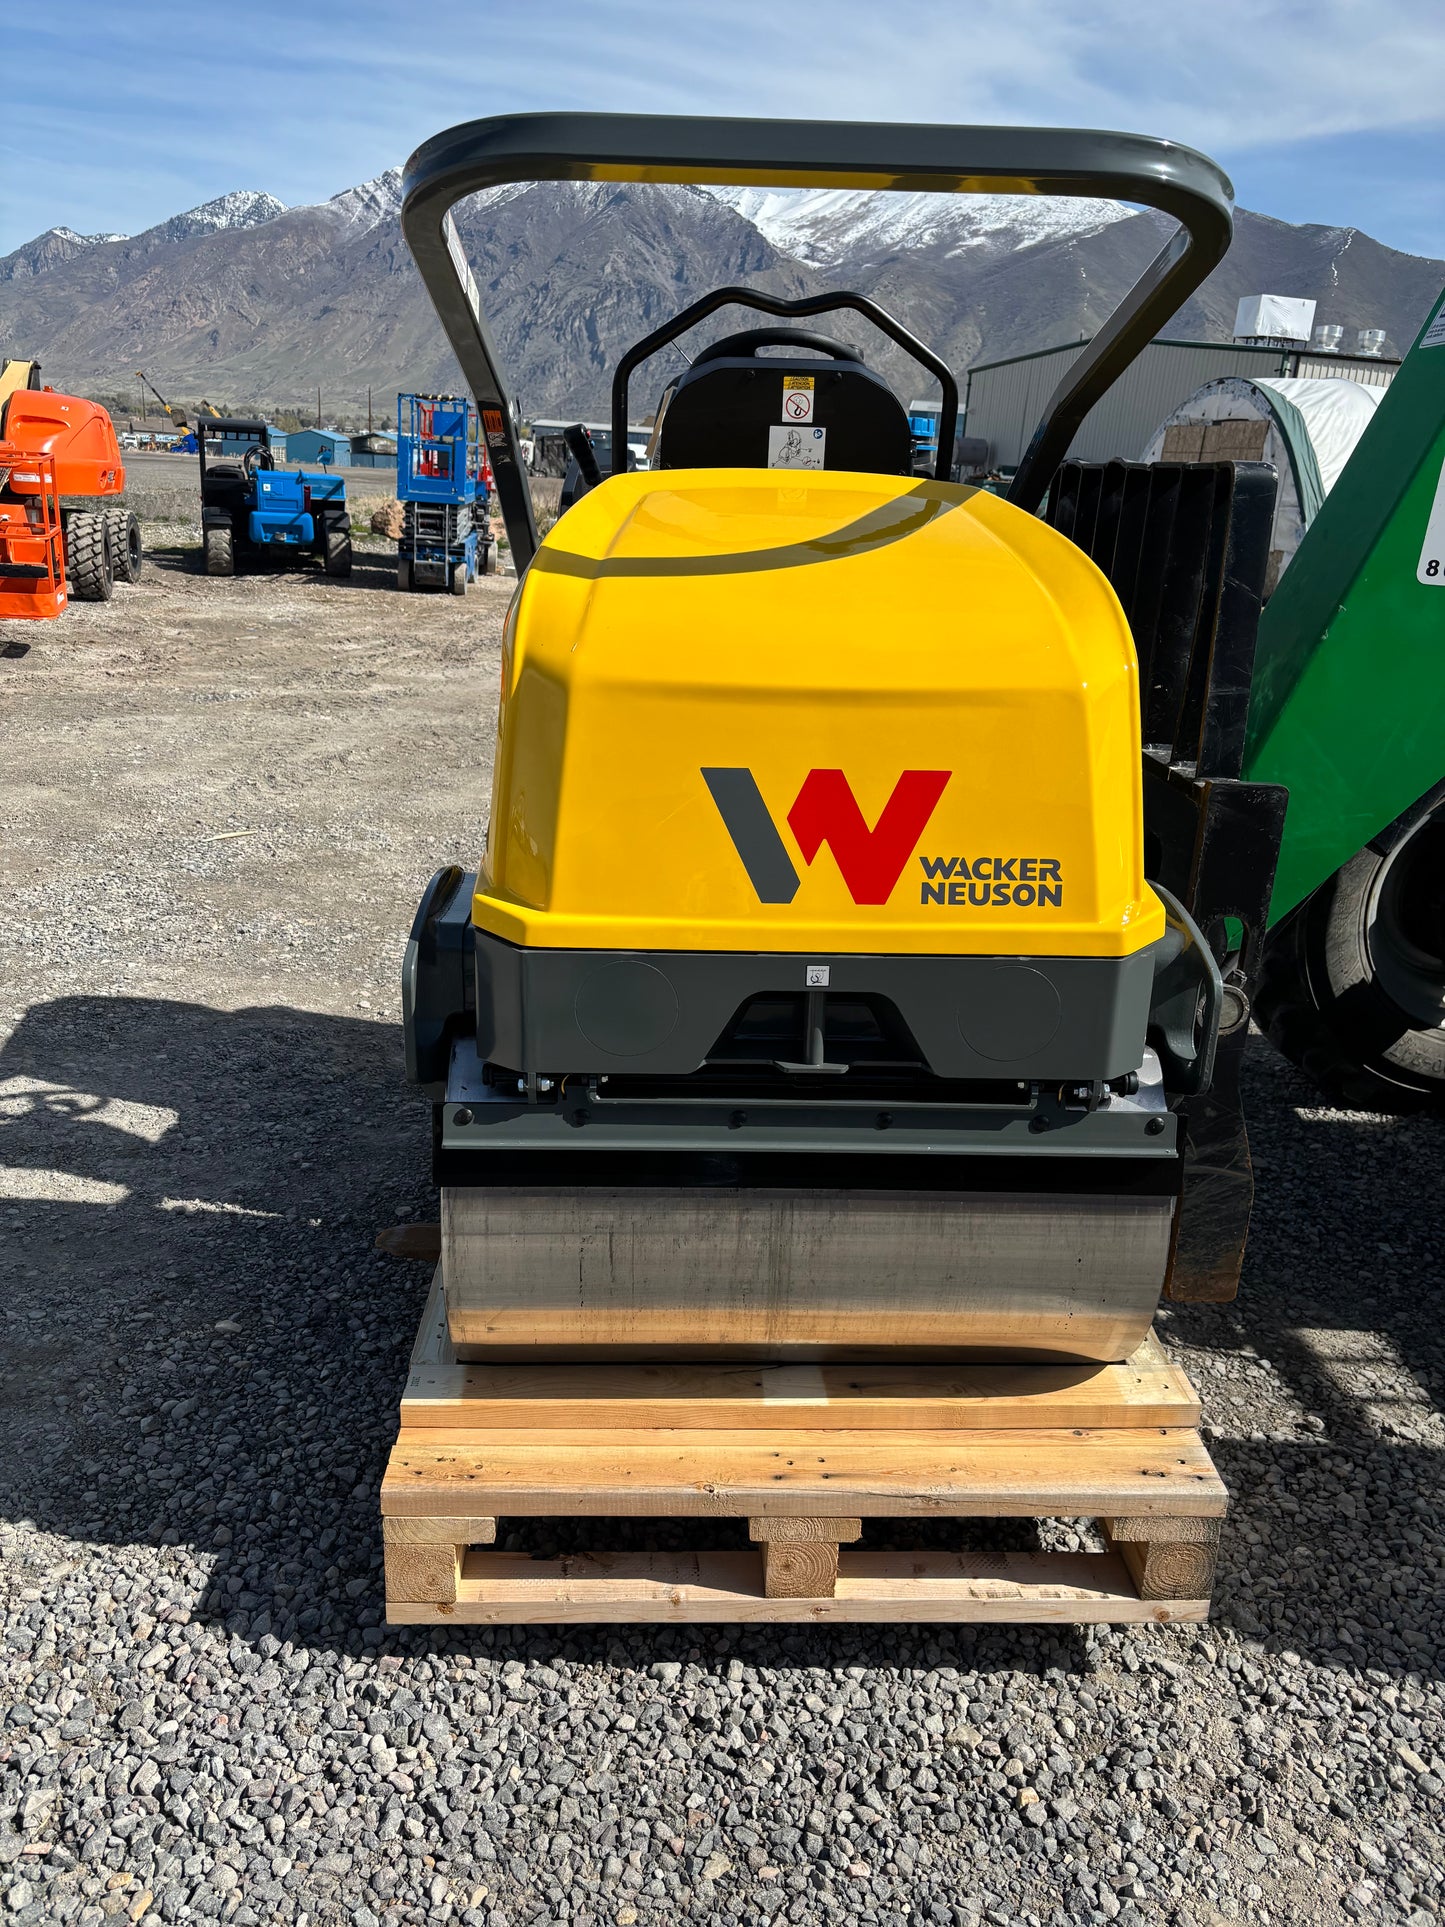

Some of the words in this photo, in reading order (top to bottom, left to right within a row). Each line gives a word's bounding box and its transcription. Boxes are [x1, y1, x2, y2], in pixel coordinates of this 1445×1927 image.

[1425, 559, 1445, 577] 8
[919, 857, 1063, 882] WACKER
[920, 882, 1063, 907] NEUSON
